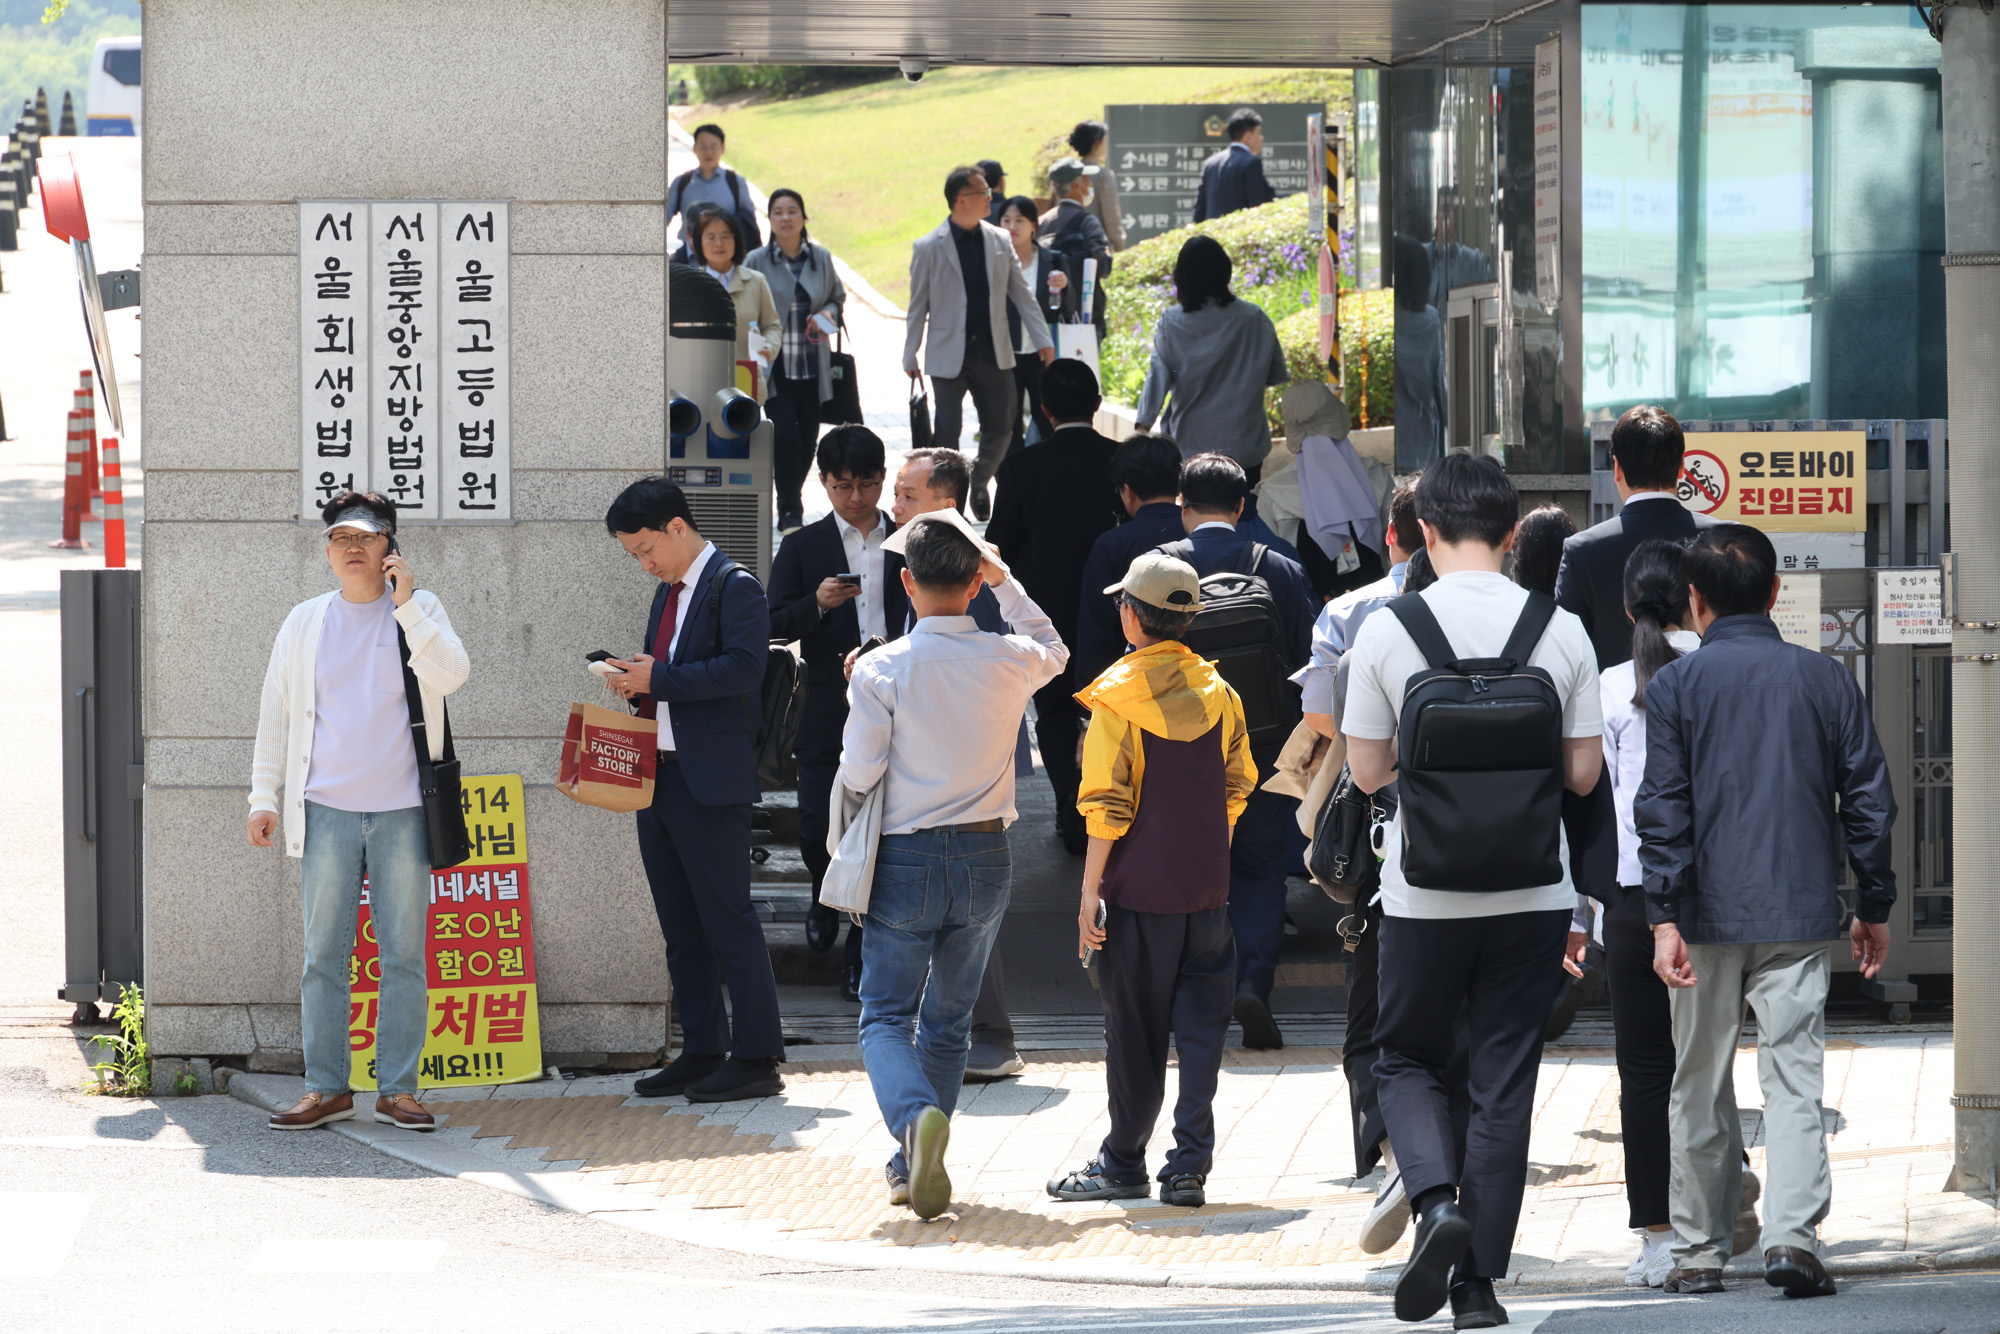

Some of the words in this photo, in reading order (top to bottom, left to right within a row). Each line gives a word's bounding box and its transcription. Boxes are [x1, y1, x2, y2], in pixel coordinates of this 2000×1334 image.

[385, 212, 425, 509] 서울중앙지방법원
[456, 210, 497, 510] 서울고등법원
[1739, 450, 1854, 479] 오토바이
[1739, 486, 1853, 516] 진입금지
[591, 740, 641, 764] FACTORY
[599, 729, 634, 746] SHINSEGAE
[597, 756, 633, 776] STORE
